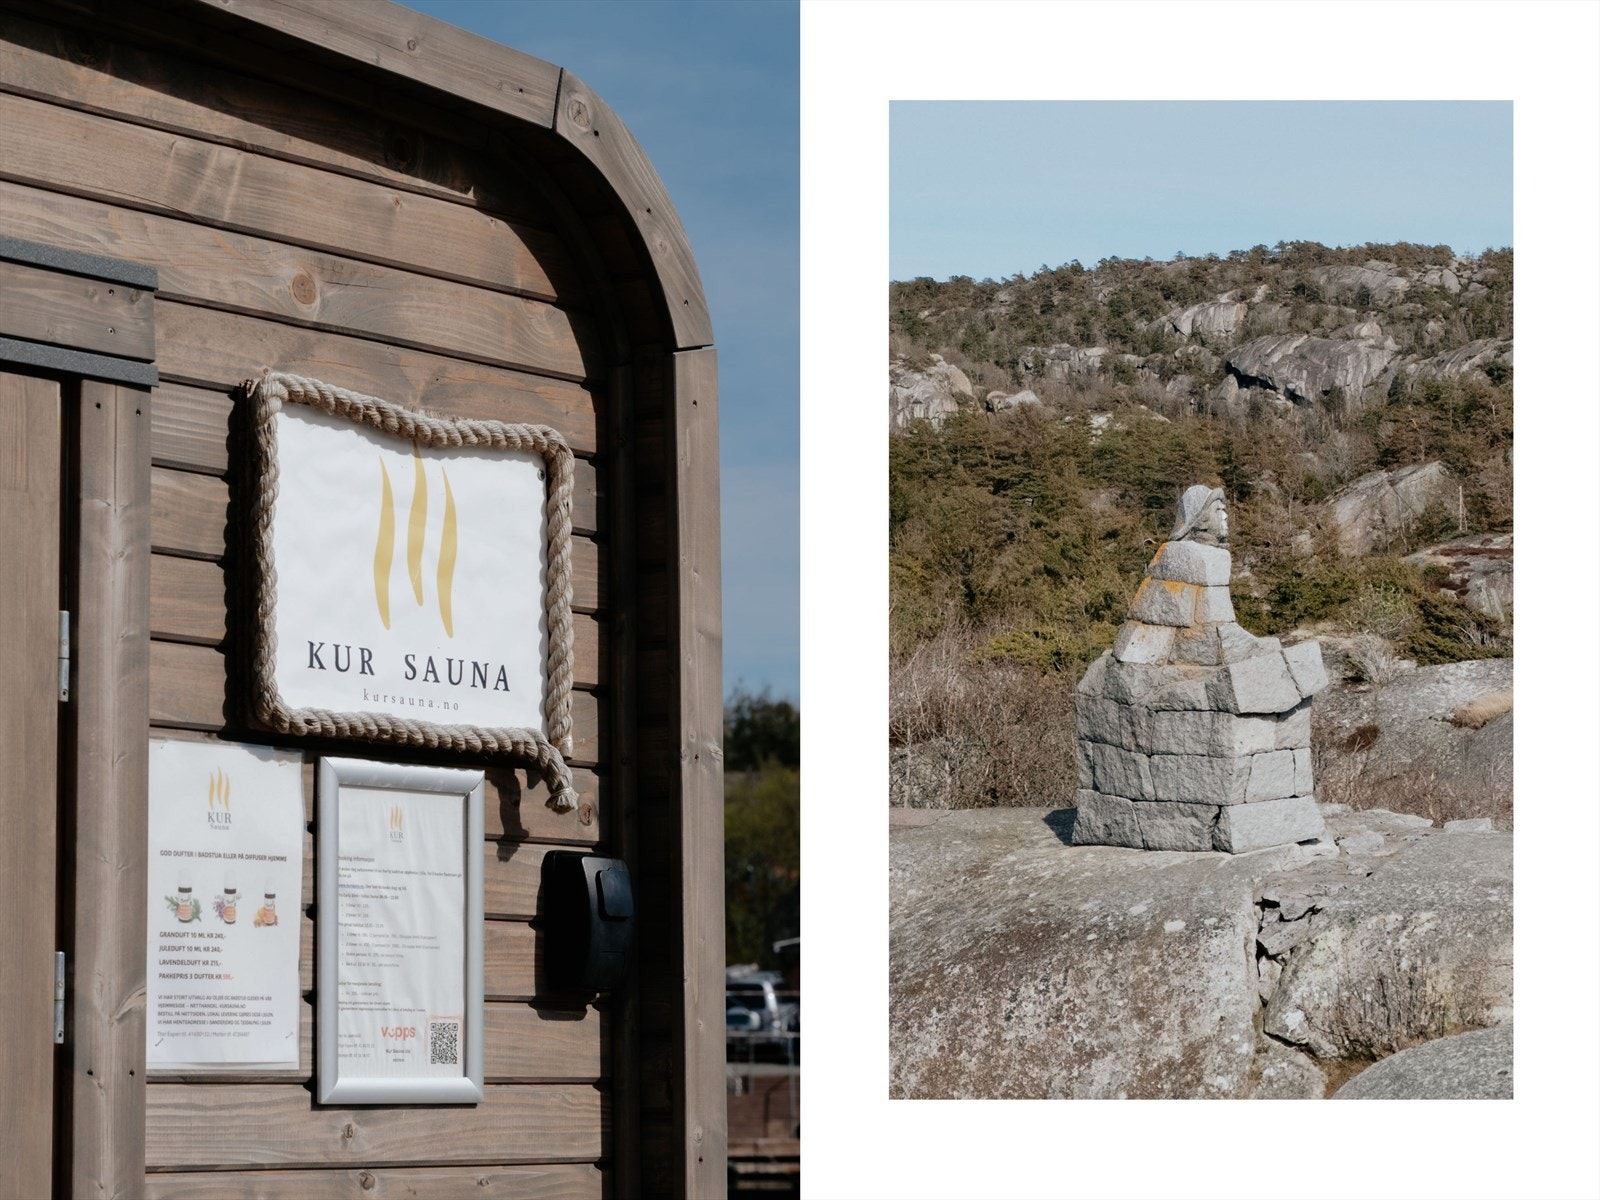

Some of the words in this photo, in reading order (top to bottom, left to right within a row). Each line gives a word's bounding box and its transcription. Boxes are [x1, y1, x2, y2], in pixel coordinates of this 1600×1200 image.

[307, 640, 375, 676] KUR
[404, 653, 511, 692] SAUNA
[363, 688, 459, 711] kursauna.no
[207, 811, 232, 824] KUR
[160, 849, 172, 857] GOD
[173, 850, 194, 858] DUFTER
[198, 851, 222, 859] BADSTUA
[238, 852, 244, 860] PÅ
